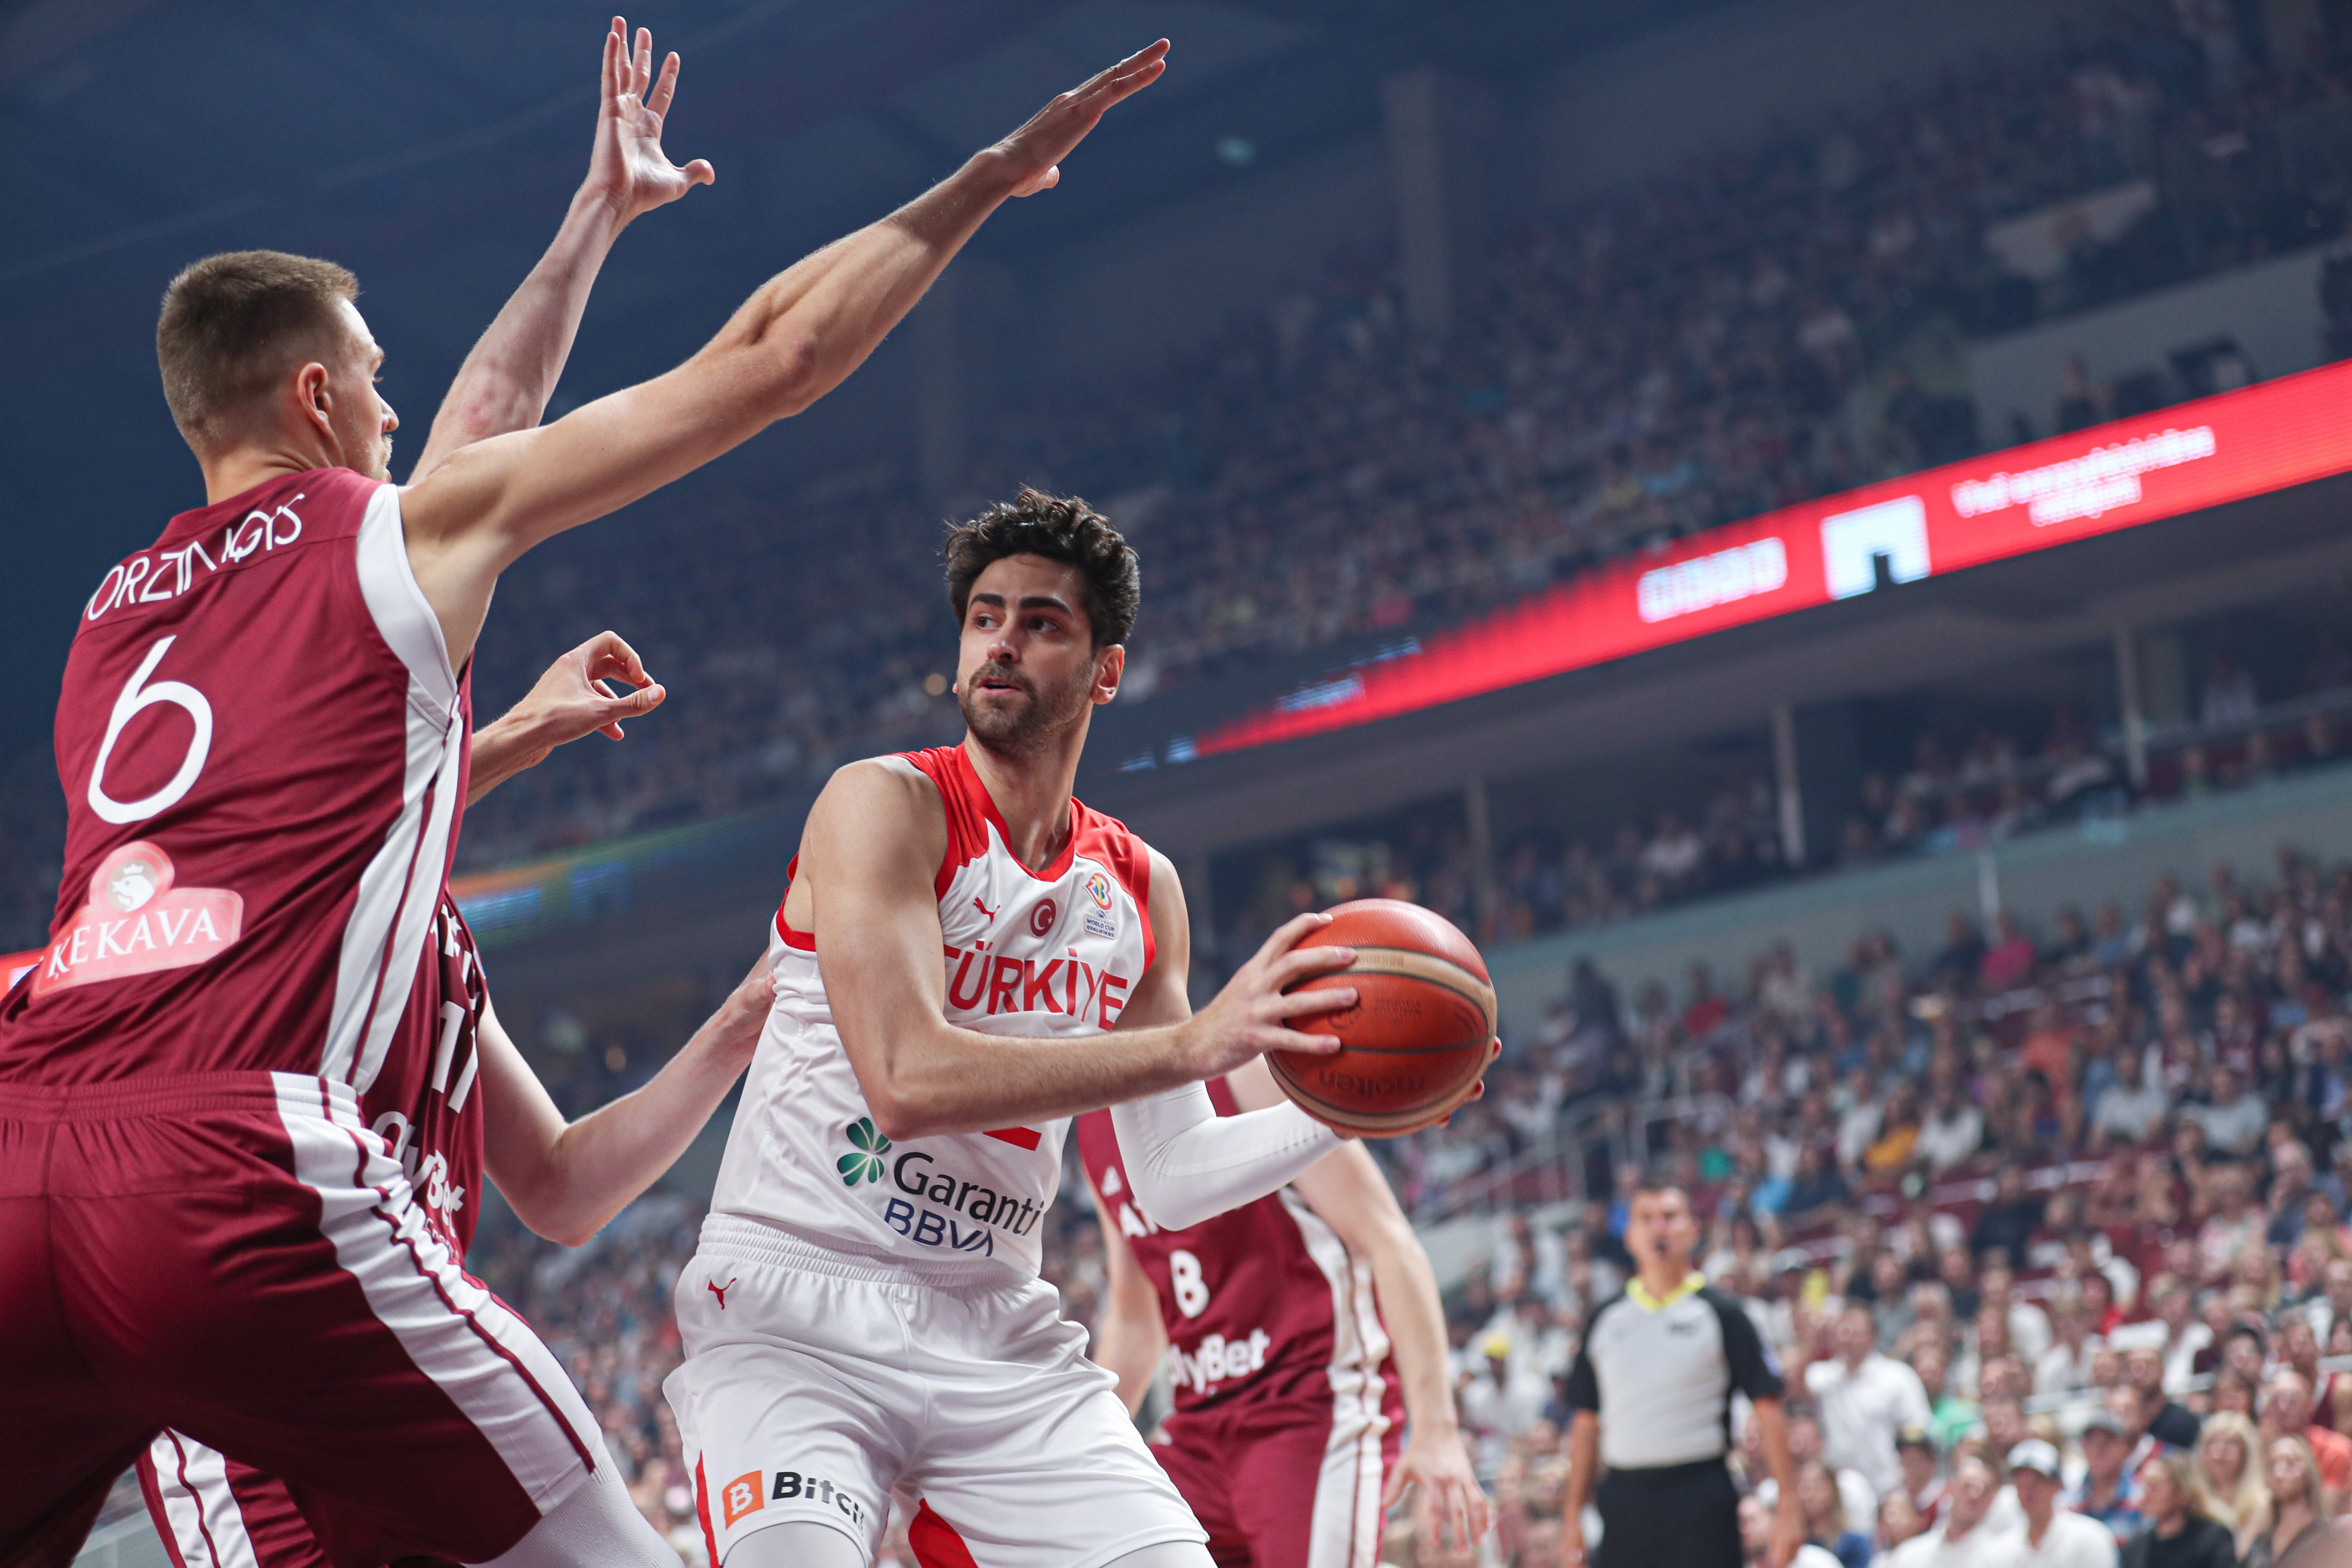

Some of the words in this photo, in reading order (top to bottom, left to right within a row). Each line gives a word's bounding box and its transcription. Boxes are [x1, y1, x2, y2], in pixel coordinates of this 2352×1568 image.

[87, 634, 213, 824] 6
[1105, 924, 1115, 932] CUP
[884, 1197, 994, 1258] BBVA
[893, 1151, 1044, 1237] Garanti
